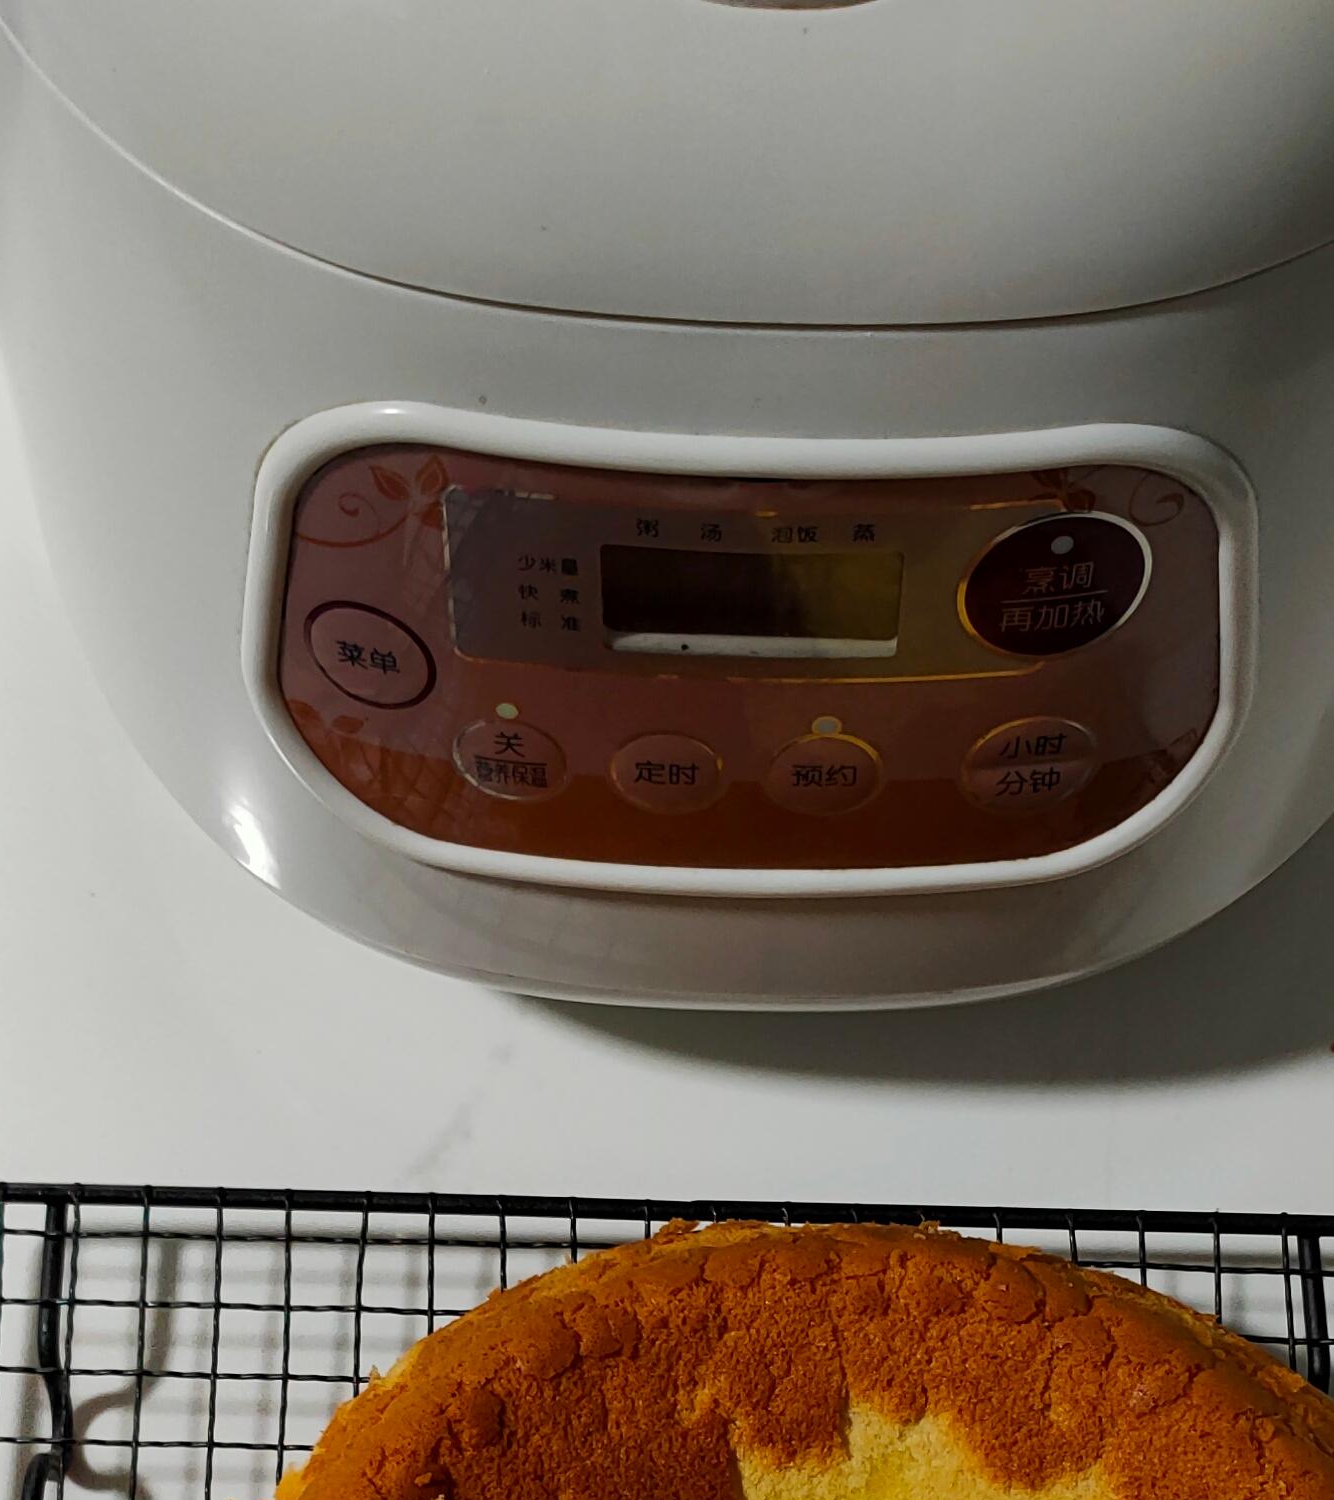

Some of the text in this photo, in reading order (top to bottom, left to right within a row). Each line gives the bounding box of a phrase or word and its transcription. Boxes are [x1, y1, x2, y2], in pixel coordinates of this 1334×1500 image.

[700, 523, 722, 543] 汤
[1022, 561, 1096, 594] 烹调
[999, 597, 1105, 633] 再加热
[336, 641, 400, 675] 菜单
[493, 731, 526, 758] 关
[999, 733, 1068, 759] 小时
[634, 761, 700, 787] 定时
[792, 764, 858, 788] 预约
[996, 767, 1062, 797] 分钟
